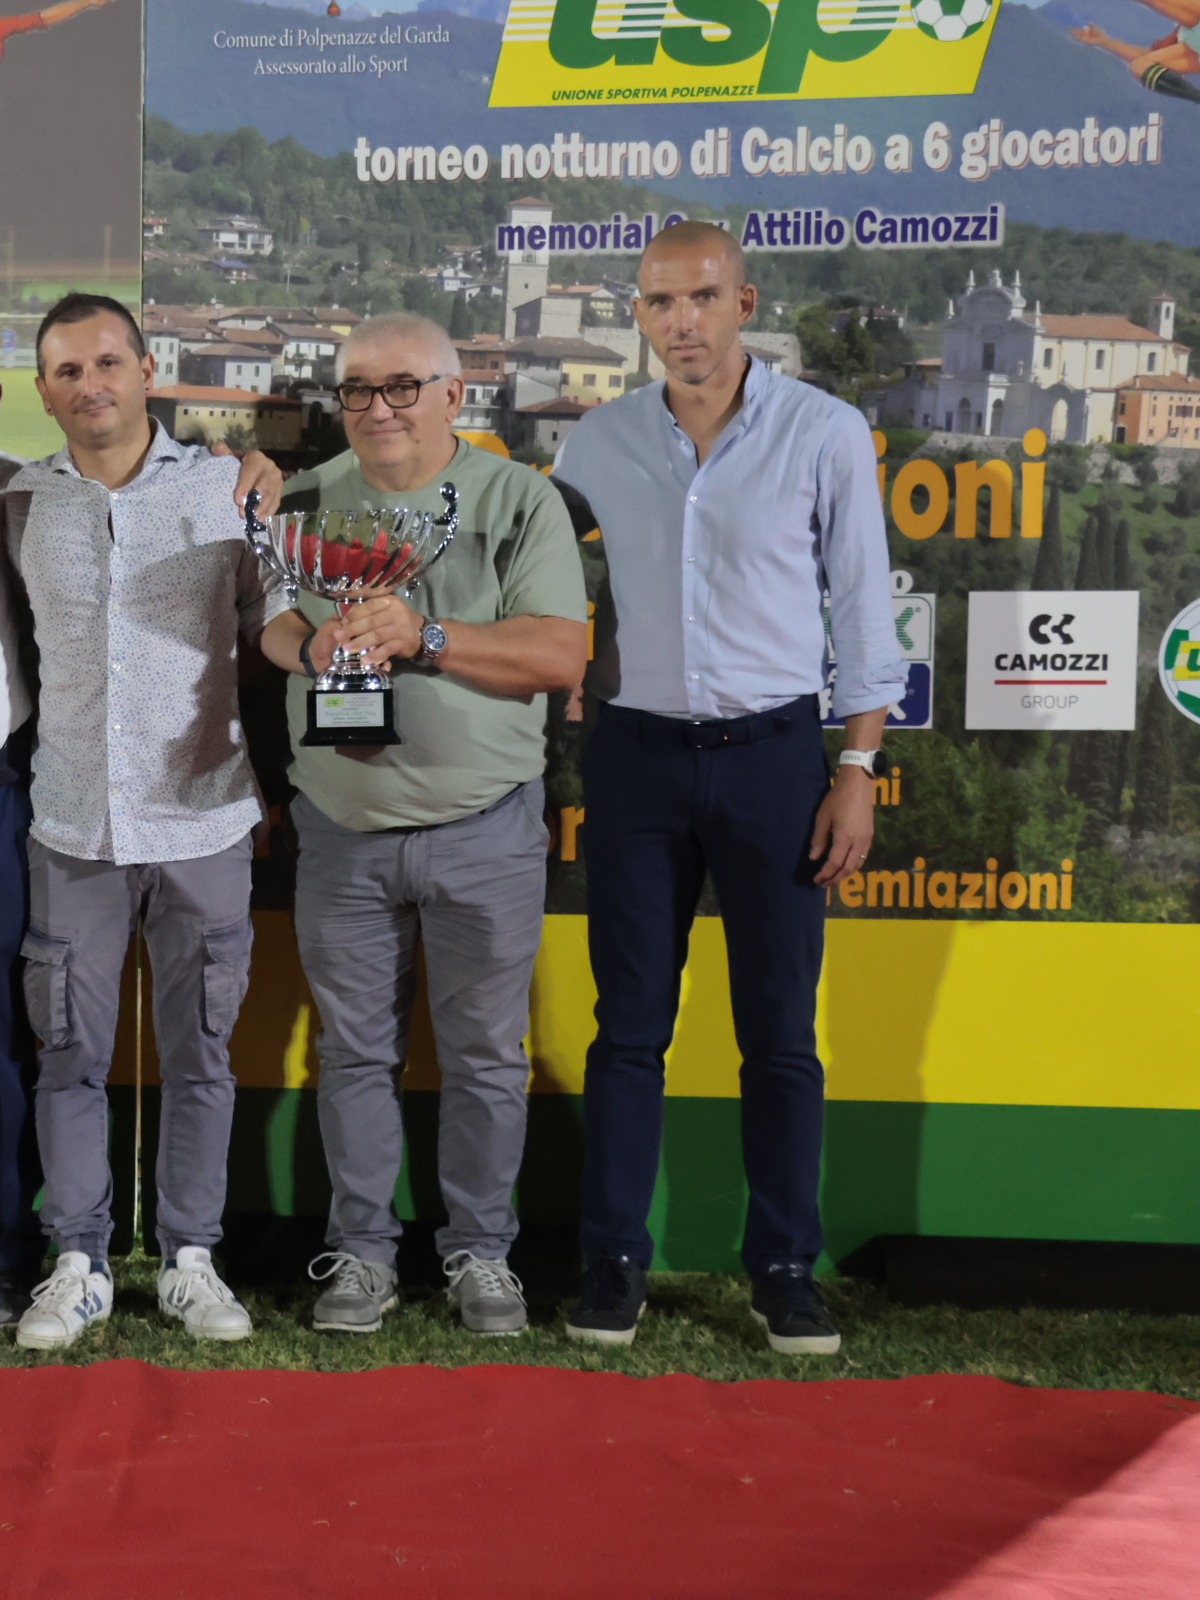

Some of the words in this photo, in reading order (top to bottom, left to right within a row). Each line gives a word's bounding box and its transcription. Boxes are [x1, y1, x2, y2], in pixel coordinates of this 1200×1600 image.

[214, 31, 276, 48] Comune
[279, 29, 293, 46] di
[298, 28, 377, 51] Polpenazze
[380, 26, 401, 44] del
[405, 25, 450, 43] Garda
[254, 58, 337, 75] Assessorato
[340, 55, 366, 73] allo
[369, 55, 409, 78] Sport
[552, 90, 603, 101] UNIONE
[607, 88, 668, 99] SPORTIVA
[671, 85, 755, 98] POLPENAZZE
[355, 137, 488, 182] torneo
[501, 132, 679, 180] notturno
[690, 128, 729, 177] di
[741, 124, 873, 175] Calcio
[884, 134, 911, 171] a
[923, 121, 951, 170] 6
[960, 112, 1161, 181] giocatori
[498, 214, 652, 251] memorial
[742, 210, 845, 247] Attilio
[855, 205, 999, 244] Camozzi
[995, 654, 1108, 671] CAMOZZI
[1021, 695, 1079, 709] GROUP
